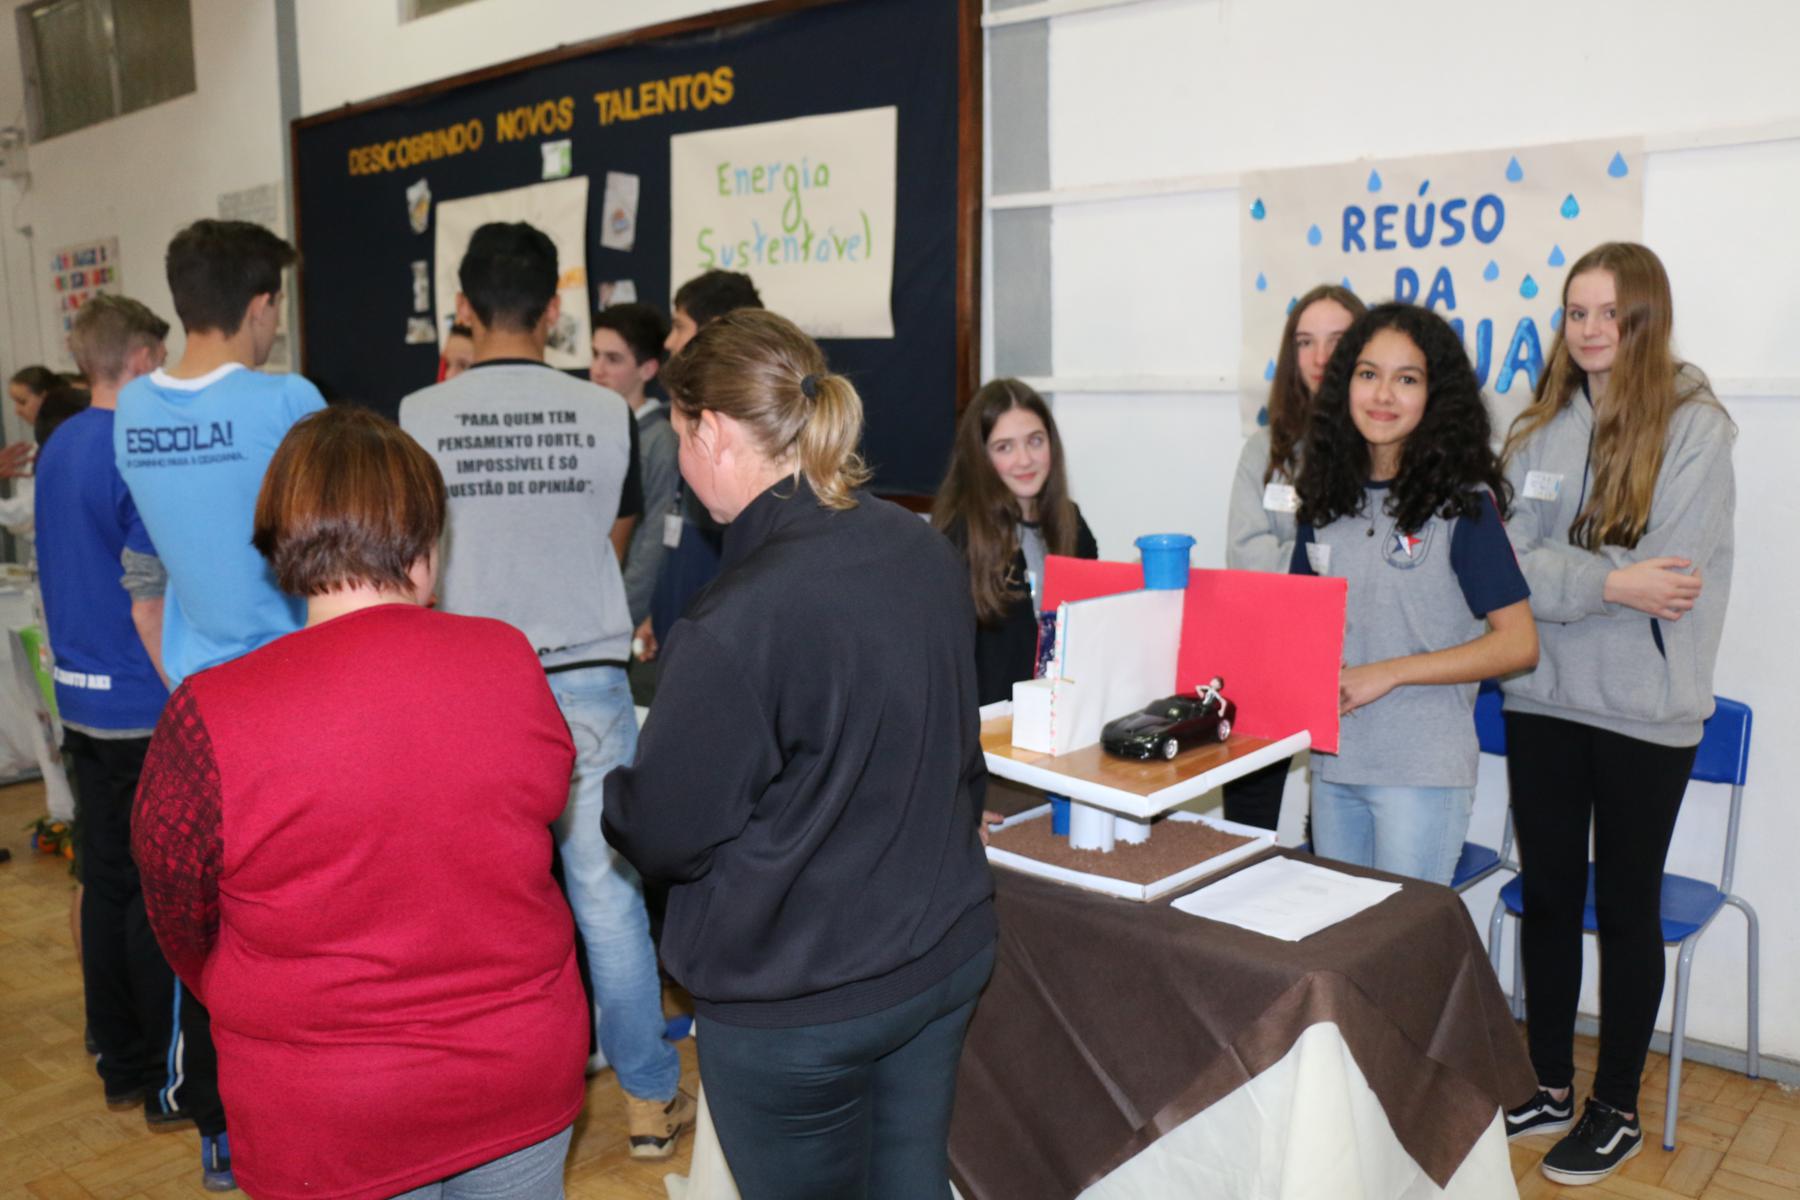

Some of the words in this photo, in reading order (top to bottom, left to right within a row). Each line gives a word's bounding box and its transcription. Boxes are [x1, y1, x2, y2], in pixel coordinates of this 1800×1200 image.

[348, 119, 483, 176] DESCOBRINDO
[496, 97, 574, 143] NOVOS
[594, 66, 735, 126] TALENTOS
[717, 156, 829, 234] Energia
[1341, 179, 1506, 253] REÚSO
[1394, 265, 1456, 312] DA
[455, 413, 499, 427] "PARA
[503, 412, 544, 427] QUEM
[548, 410, 577, 425] TEM
[126, 420, 233, 454] ESCOLA!
[437, 435, 533, 452] PENSAMENTO
[537, 433, 583, 449] FORTE,
[586, 434, 596, 448] O
[456, 456, 543, 474] IMPOSSÍVEL
[548, 454, 555, 470] É
[559, 454, 578, 470] SÓ
[507, 481, 525, 496] DE
